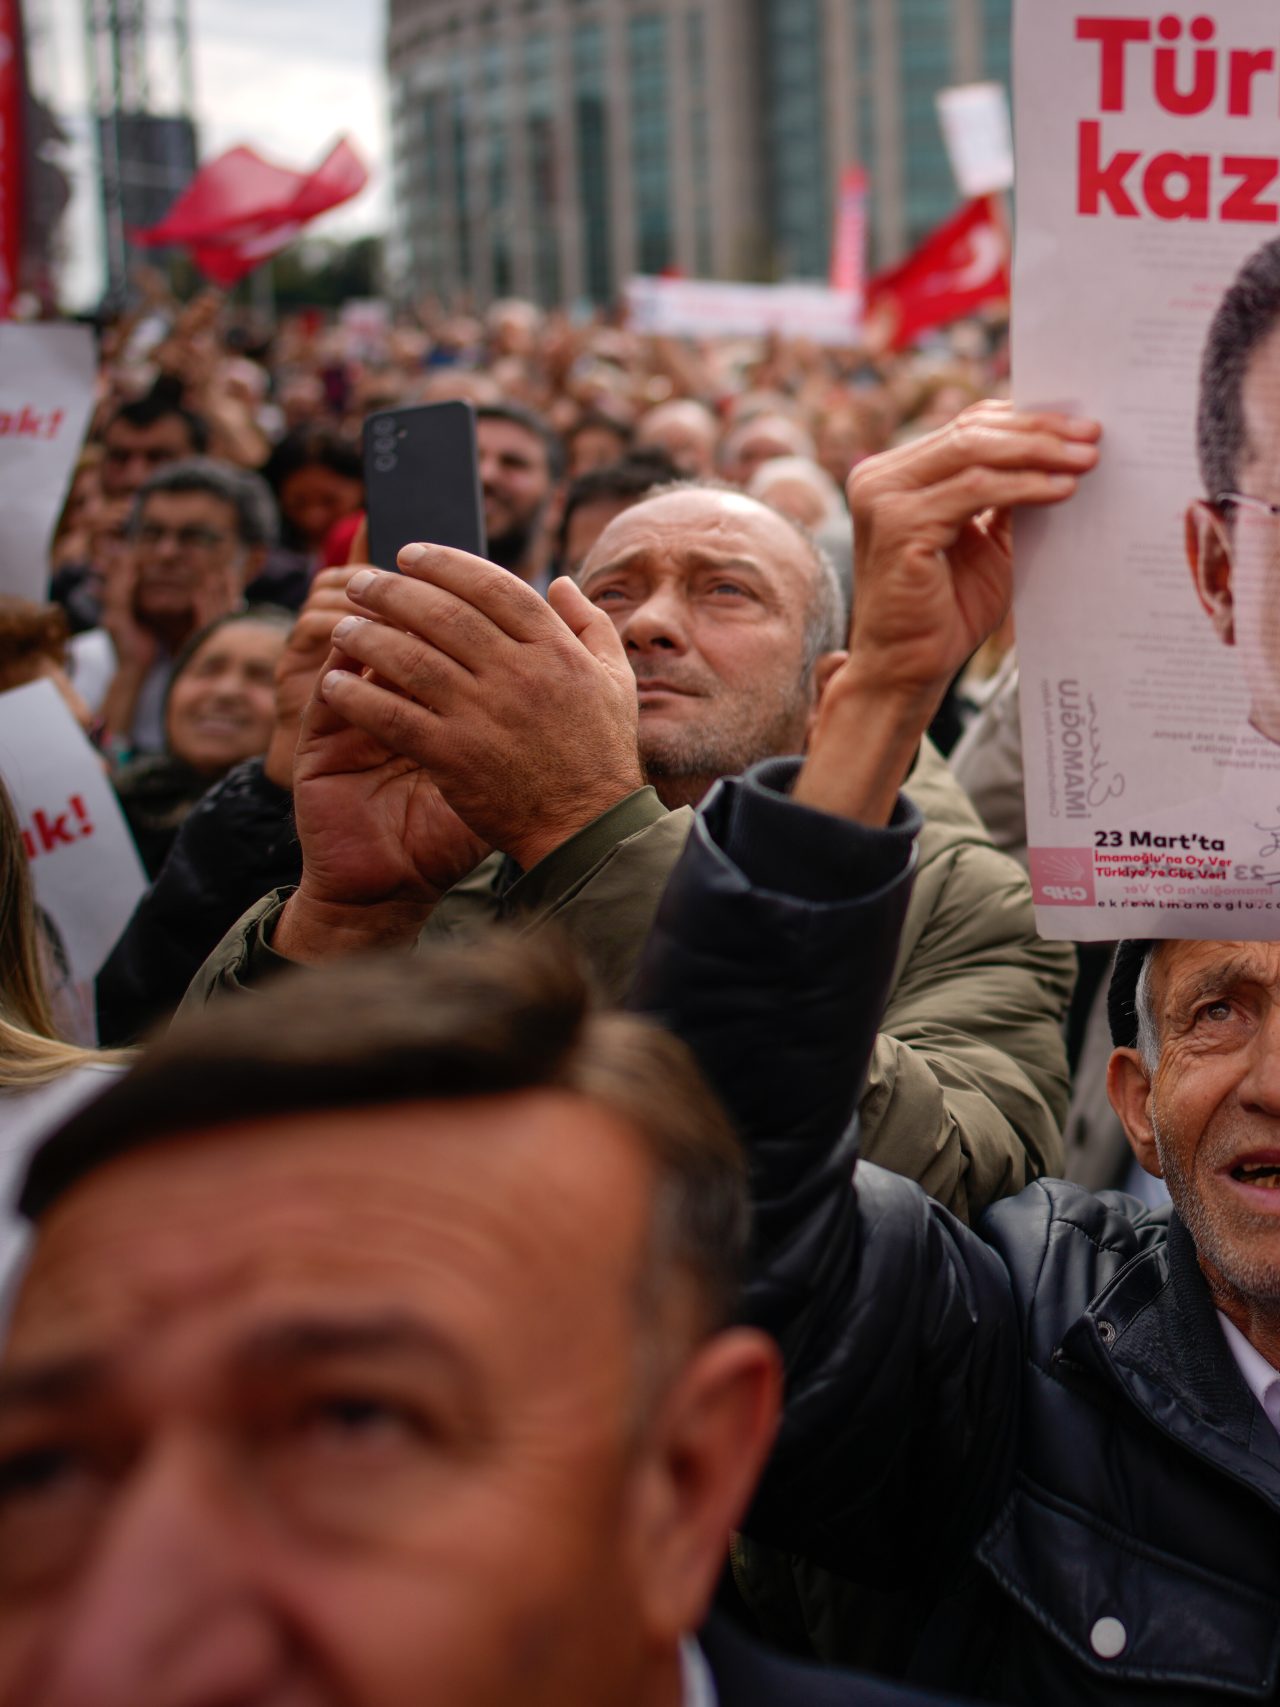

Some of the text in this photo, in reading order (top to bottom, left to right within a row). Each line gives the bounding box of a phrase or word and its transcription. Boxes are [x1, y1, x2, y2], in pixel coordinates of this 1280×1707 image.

[1094, 831, 1226, 852] 23 Mart'ta
[1095, 850, 1232, 868] İmamoğlu'na Oy Ver
[1096, 866, 1166, 880] Türkiye'ye
[1168, 867, 1196, 882] Güç
